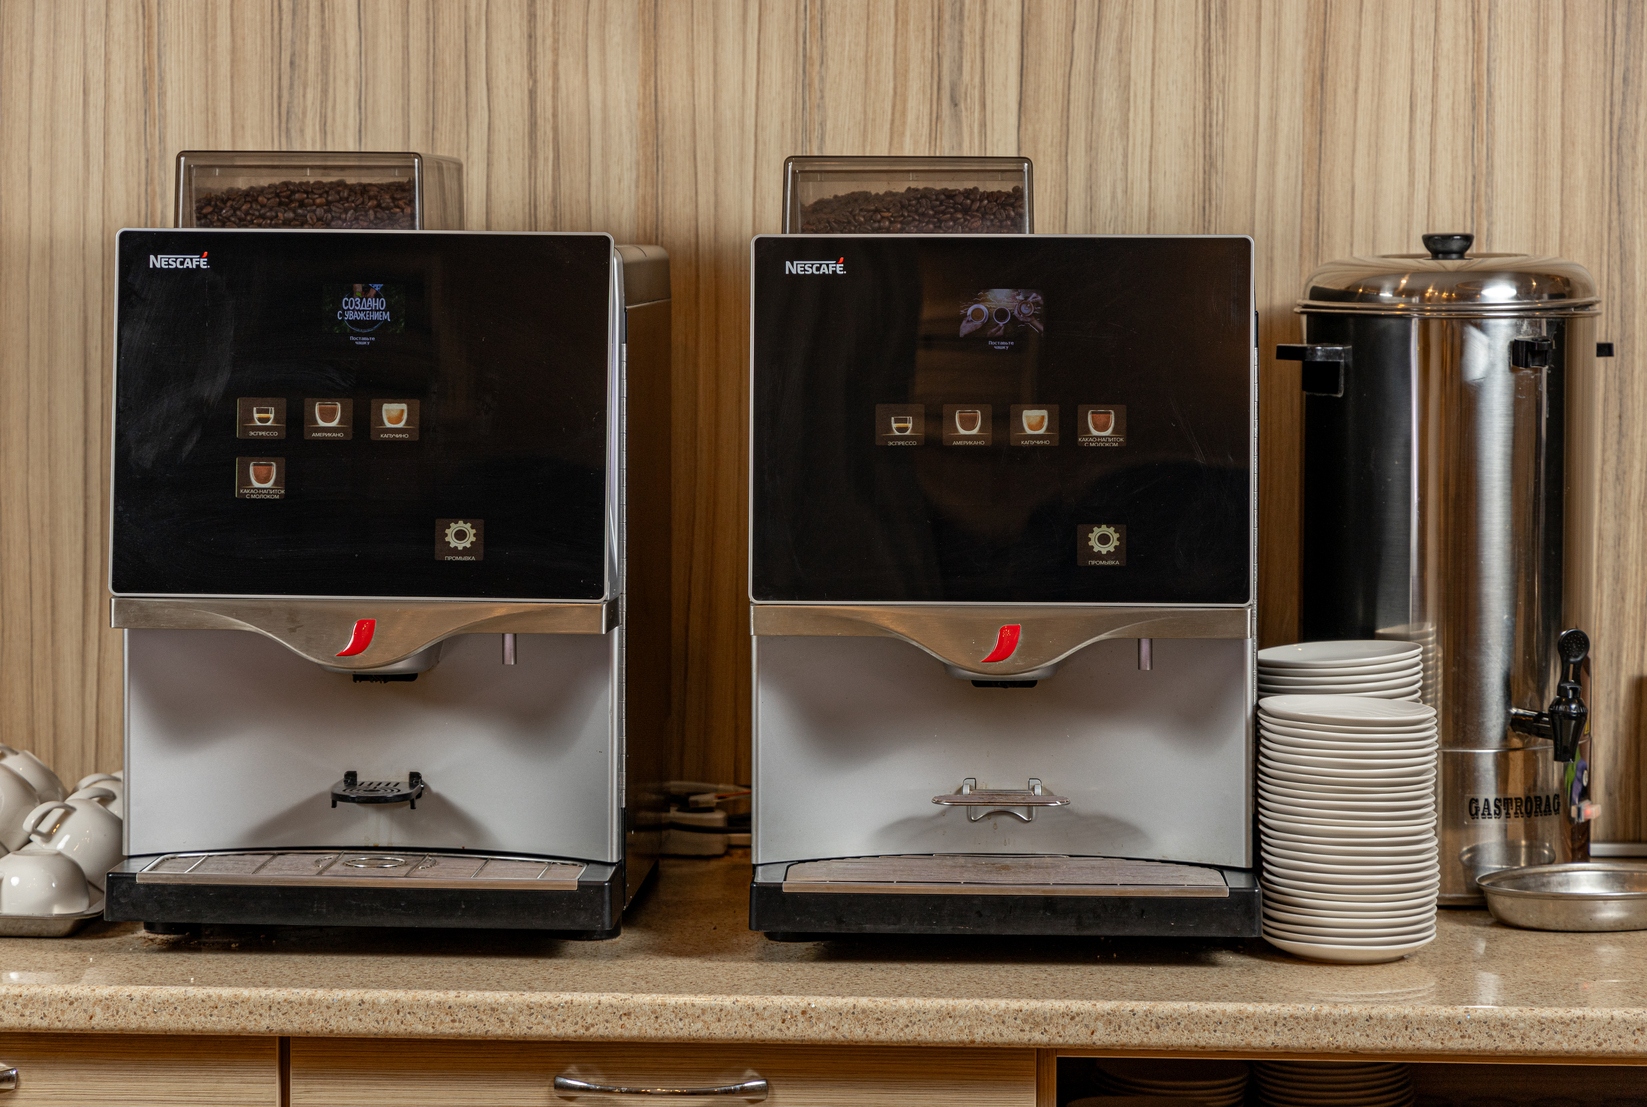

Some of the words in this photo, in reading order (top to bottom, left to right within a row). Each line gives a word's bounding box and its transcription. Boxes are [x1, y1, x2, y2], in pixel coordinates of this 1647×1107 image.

[342, 297, 387, 311] СОЗДАНО
[337, 310, 343, 320] С
[344, 310, 391, 322] УВАЖЕНИЕМ
[1468, 793, 1561, 820] GASTRORAG
